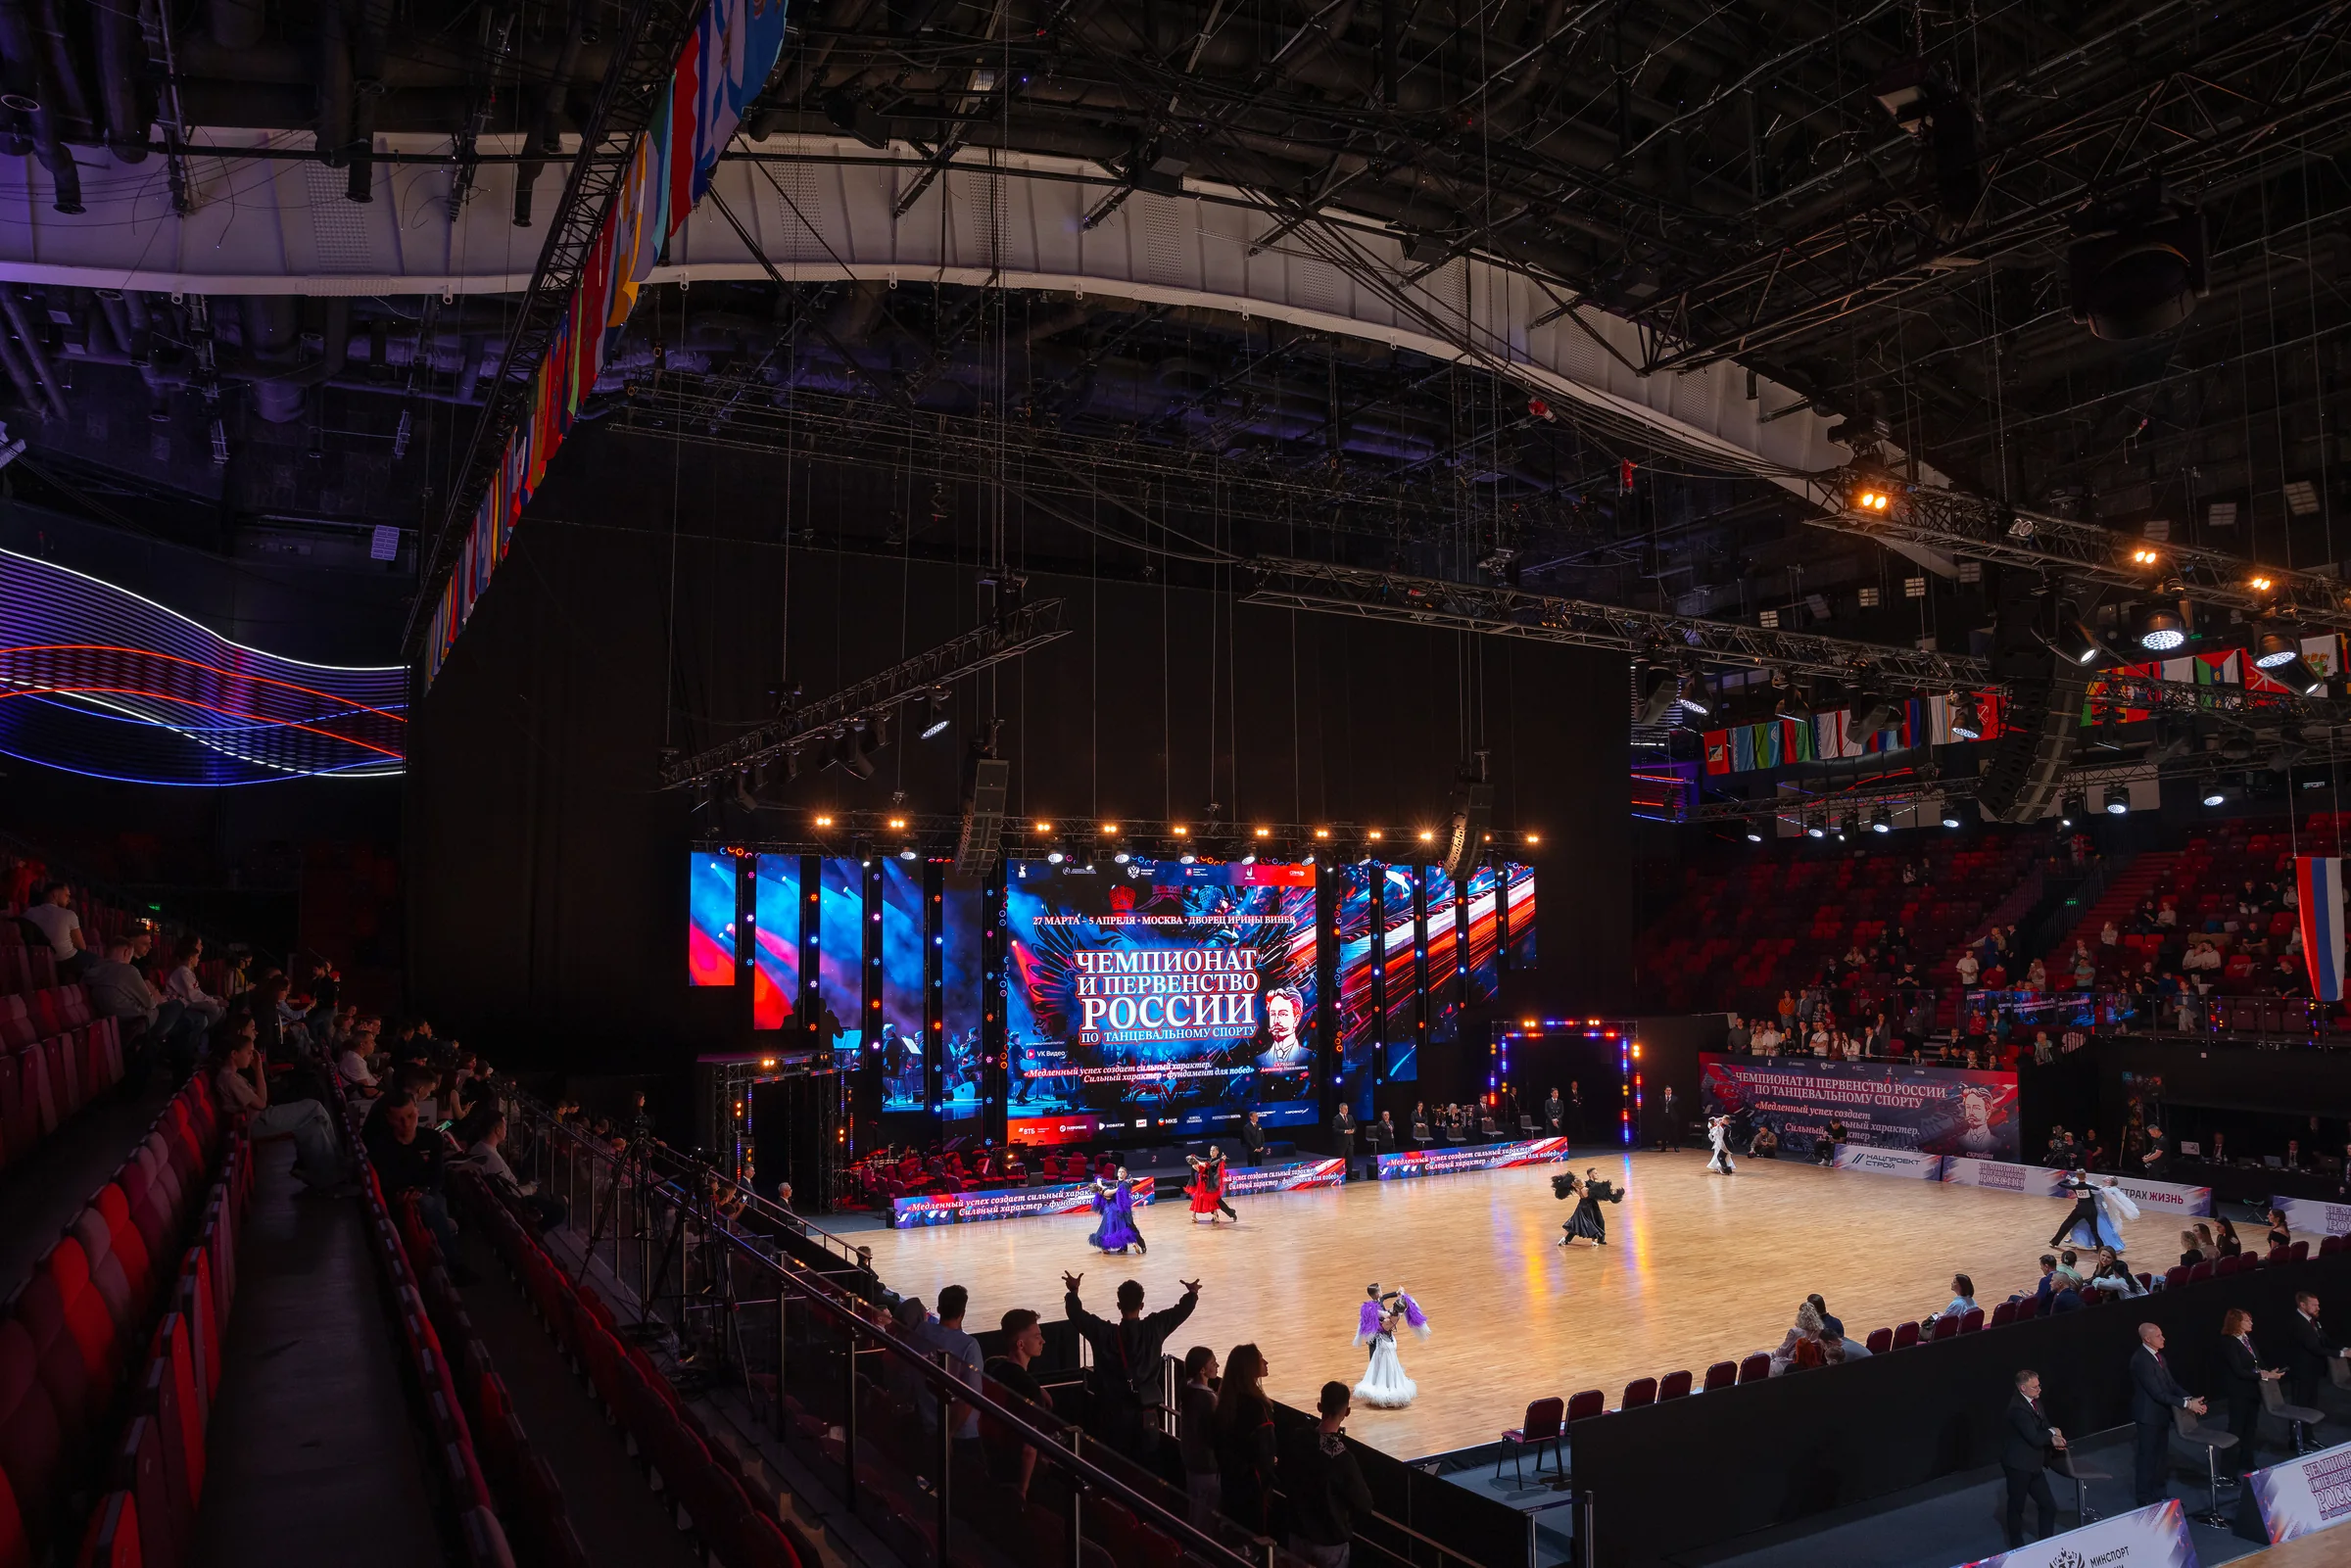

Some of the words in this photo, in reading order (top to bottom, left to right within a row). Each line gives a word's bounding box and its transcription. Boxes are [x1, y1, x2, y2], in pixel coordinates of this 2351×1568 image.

[1032, 917, 1042, 926] 27
[1044, 917, 1080, 926] МАРТА
[1088, 917, 1093, 926] 5
[1095, 917, 1136, 926] АПРЕЛЯ
[1142, 916, 1183, 925] МОСКВА
[1188, 916, 1226, 926] ДВОРЕЦ
[1227, 916, 1263, 925] ИРИНЫ
[1265, 916, 1296, 925] ВИНЕР
[1075, 949, 1257, 974] ЧЕМПИОНАТ
[1078, 976, 1097, 996] И
[1103, 973, 1258, 995] ПЕРВЕНСТВО
[1081, 993, 1256, 1030] РОССИИ
[1080, 1032, 1099, 1043] ПО
[1104, 1027, 1211, 1043] ТАНЦЕВАЛЬНОМУ
[1213, 1026, 1257, 1038] СПОРТУ
[1024, 1067, 1079, 1078] «Медленный
[1080, 1067, 1102, 1077] успех
[1103, 1065, 1135, 1073] создает
[1136, 1061, 1171, 1072] сильный
[1083, 1072, 1121, 1083] Сильный
[1122, 1072, 1162, 1082] характер
[1167, 1069, 1214, 1080] фундамент
[1215, 1068, 1228, 1076] для
[1229, 1066, 1255, 1075] побед»
[1735, 1072, 1803, 1087] ЧЕМПИОНАТ
[1805, 1078, 1814, 1087] И
[1816, 1078, 1892, 1094] ПЕРВЕНСТВО
[1895, 1084, 1945, 1098] РОССИИ
[1754, 1085, 1771, 1095] ПО
[1772, 1086, 1872, 1104] ТАНЦЕВАЛЬНОМУ
[1875, 1094, 1923, 1109] СПОРТУ
[1754, 1101, 1808, 1114] «Медленный
[1809, 1108, 1834, 1117] успех
[1835, 1110, 1871, 1120] создает
[1870, 1123, 1920, 1137] характер.
[1865, 1160, 1895, 1169] СТРОЙ
[1866, 1154, 1920, 1165] НАЦПРОЕКТ
[906, 1199, 964, 1212] «Медленный
[965, 1197, 989, 1209] успех
[990, 1193, 1026, 1205] создает
[1027, 1189, 1064, 1202] сильный
[1065, 1188, 1094, 1200] харак
[2149, 1191, 2184, 1205] ЖИЗНЬ
[958, 1204, 999, 1216] Сильный
[999, 1202, 1041, 1214] характер
[2089, 1546, 2130, 1567] МИНСПОРТ
